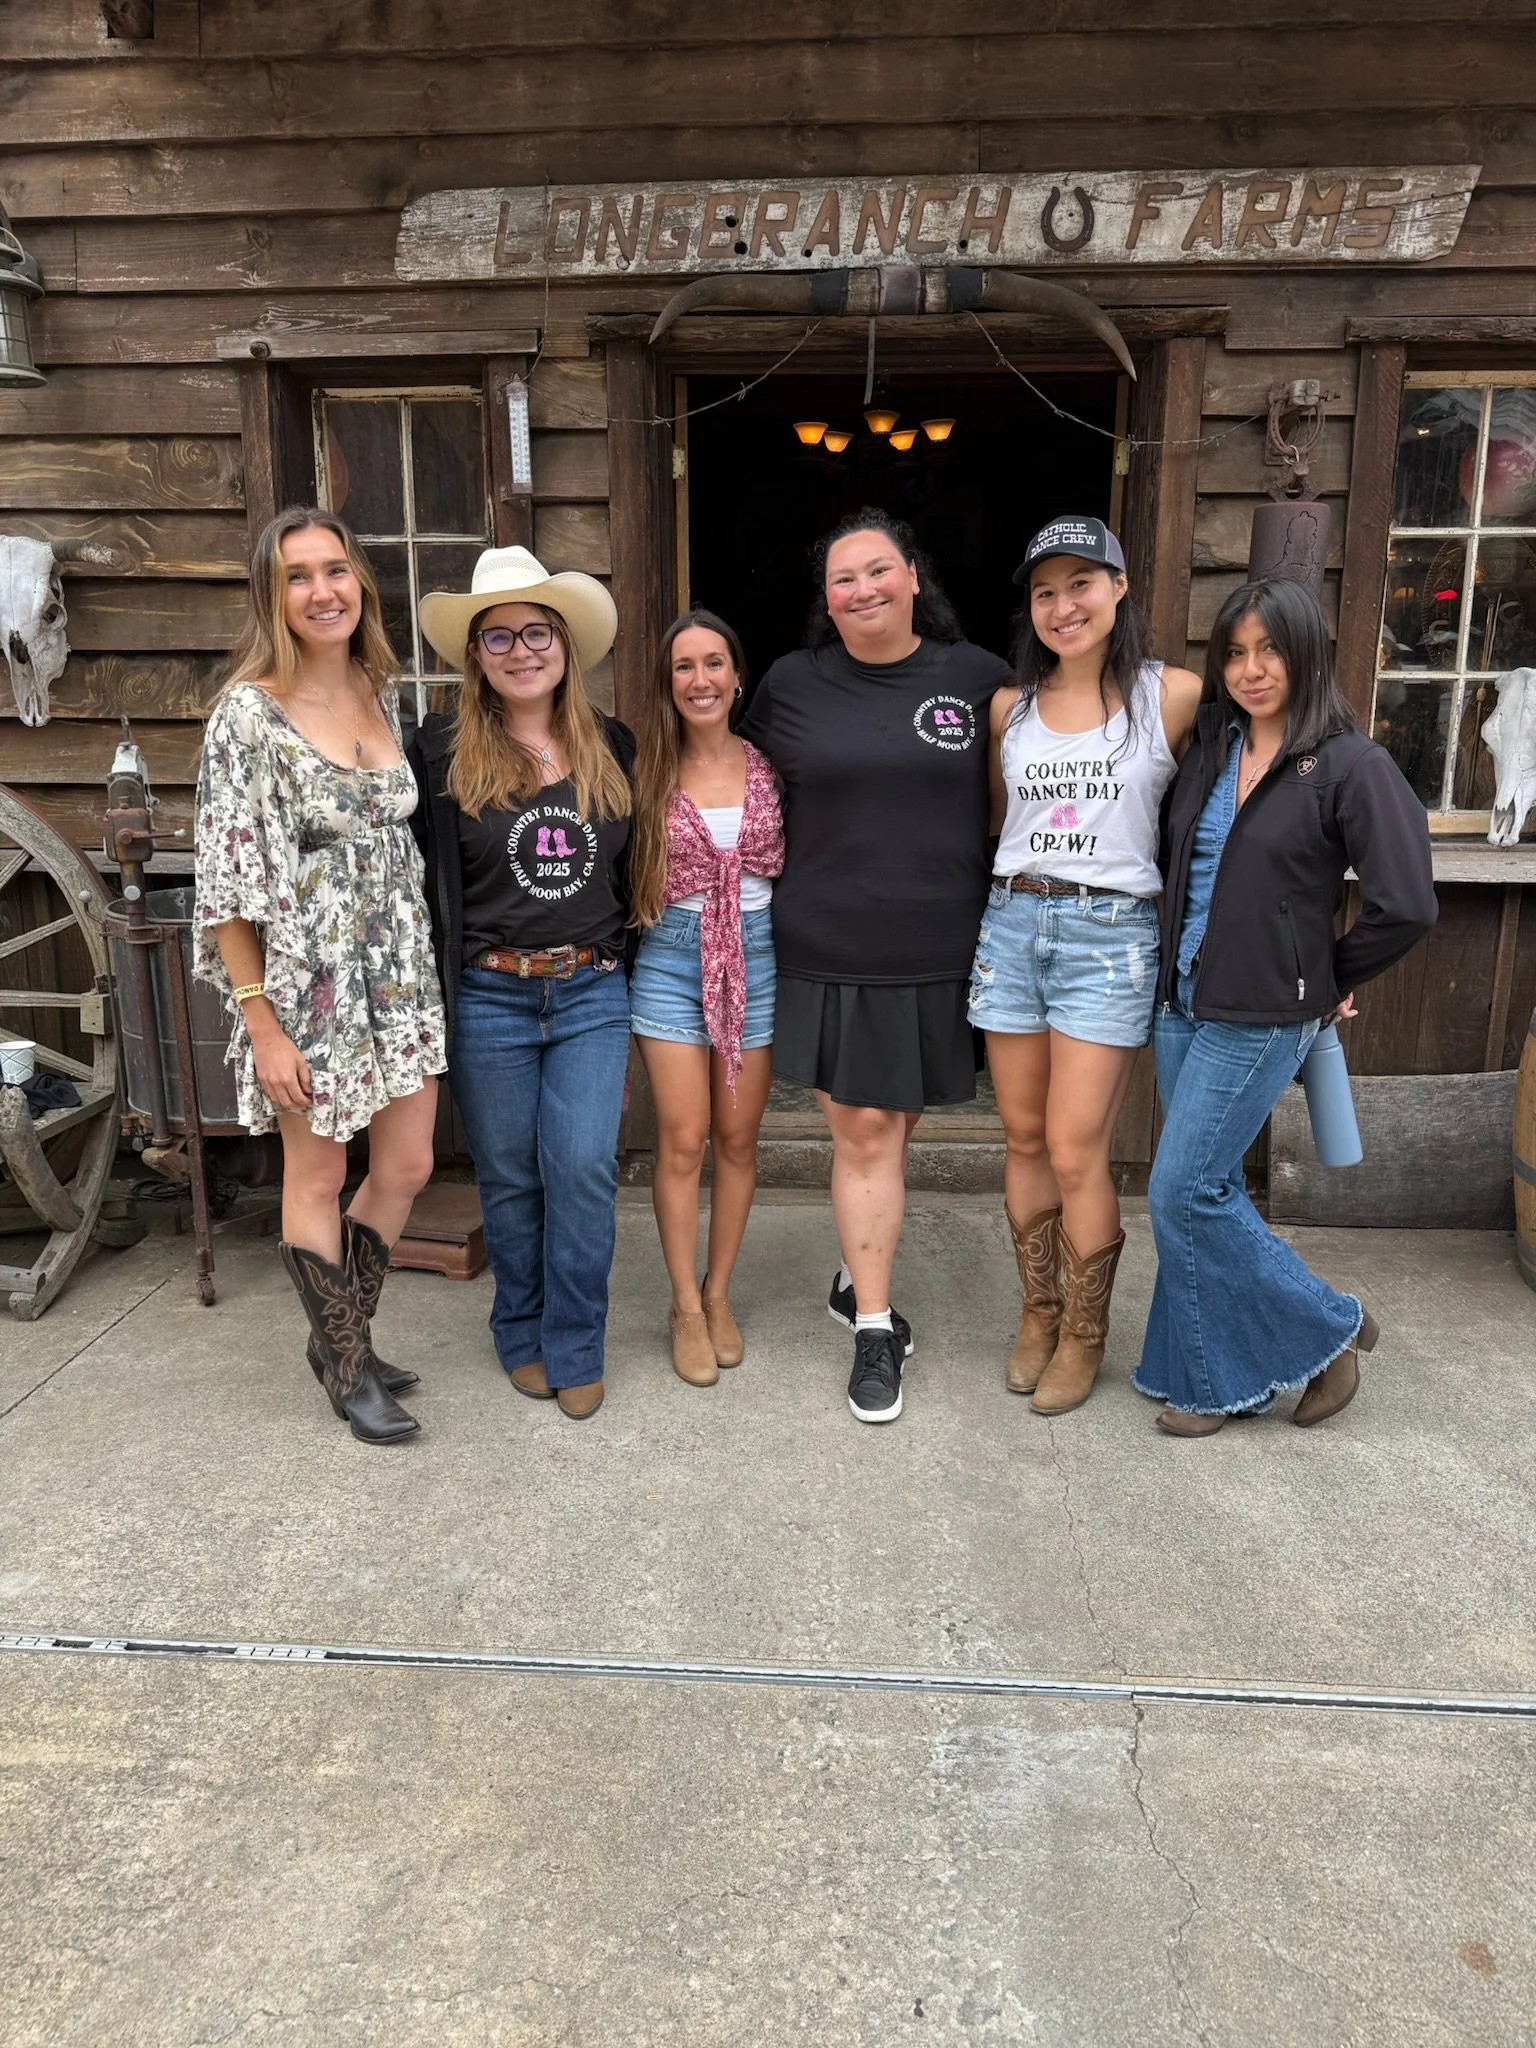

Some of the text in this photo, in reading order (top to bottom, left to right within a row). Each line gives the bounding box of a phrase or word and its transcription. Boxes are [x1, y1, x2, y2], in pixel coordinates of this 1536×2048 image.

[493, 178, 1403, 264] LONGBRANCH FARMS
[1037, 523, 1087, 542] CATHOLIC
[1030, 534, 1096, 559] DANCE CREW
[913, 697, 936, 727] COUNTRY
[937, 695, 966, 708] DANCE
[917, 729, 937, 744] HALF
[937, 740, 961, 751] MOON
[1025, 760, 1118, 780] COUNTRY
[1017, 782, 1124, 801] DANCE DAY
[507, 808, 541, 855] COUNTRY
[582, 823, 597, 852] DAY!
[510, 861, 595, 900] HALF MOON BAY, CA
[536, 862, 570, 877] 2025
